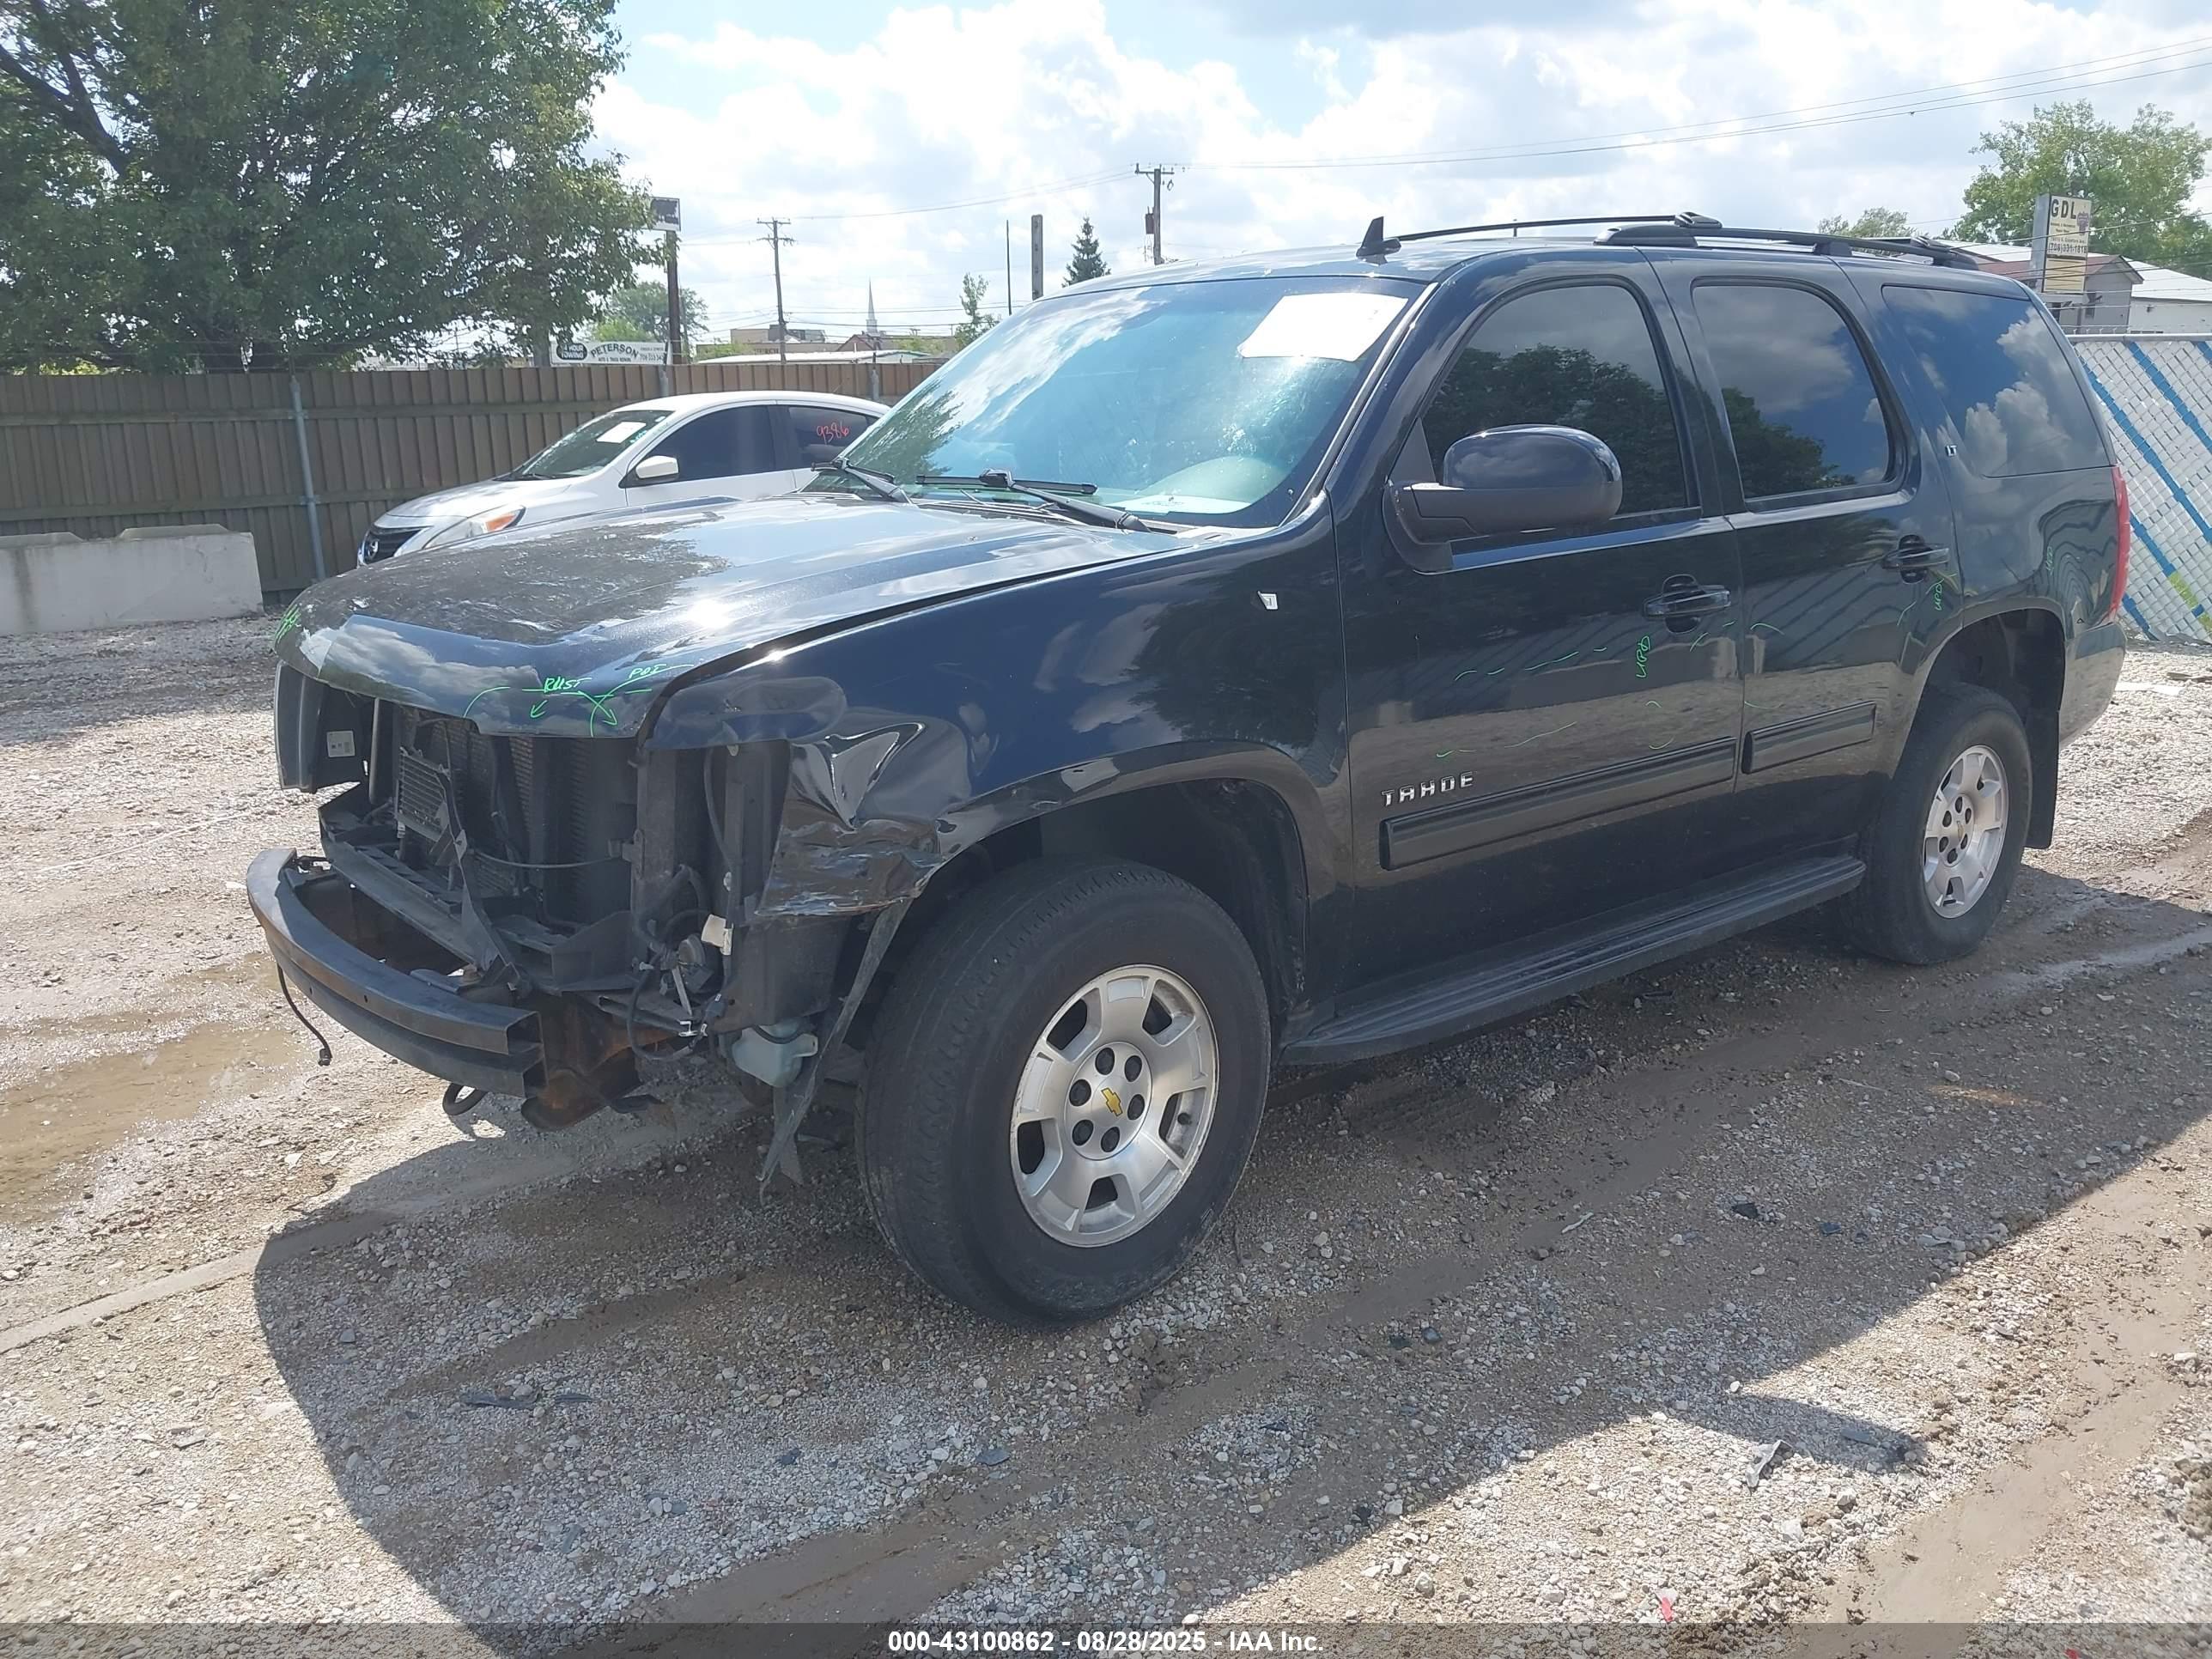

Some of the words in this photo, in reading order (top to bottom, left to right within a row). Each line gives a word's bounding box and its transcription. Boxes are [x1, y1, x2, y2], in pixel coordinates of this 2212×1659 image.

[2051, 198, 2076, 219] GDL
[591, 343, 639, 358] PETERSON
[816, 421, 849, 445] 9386
[1946, 445, 1958, 457] LT
[544, 676, 592, 693] RUST
[1382, 771, 1474, 806] TAHOE
